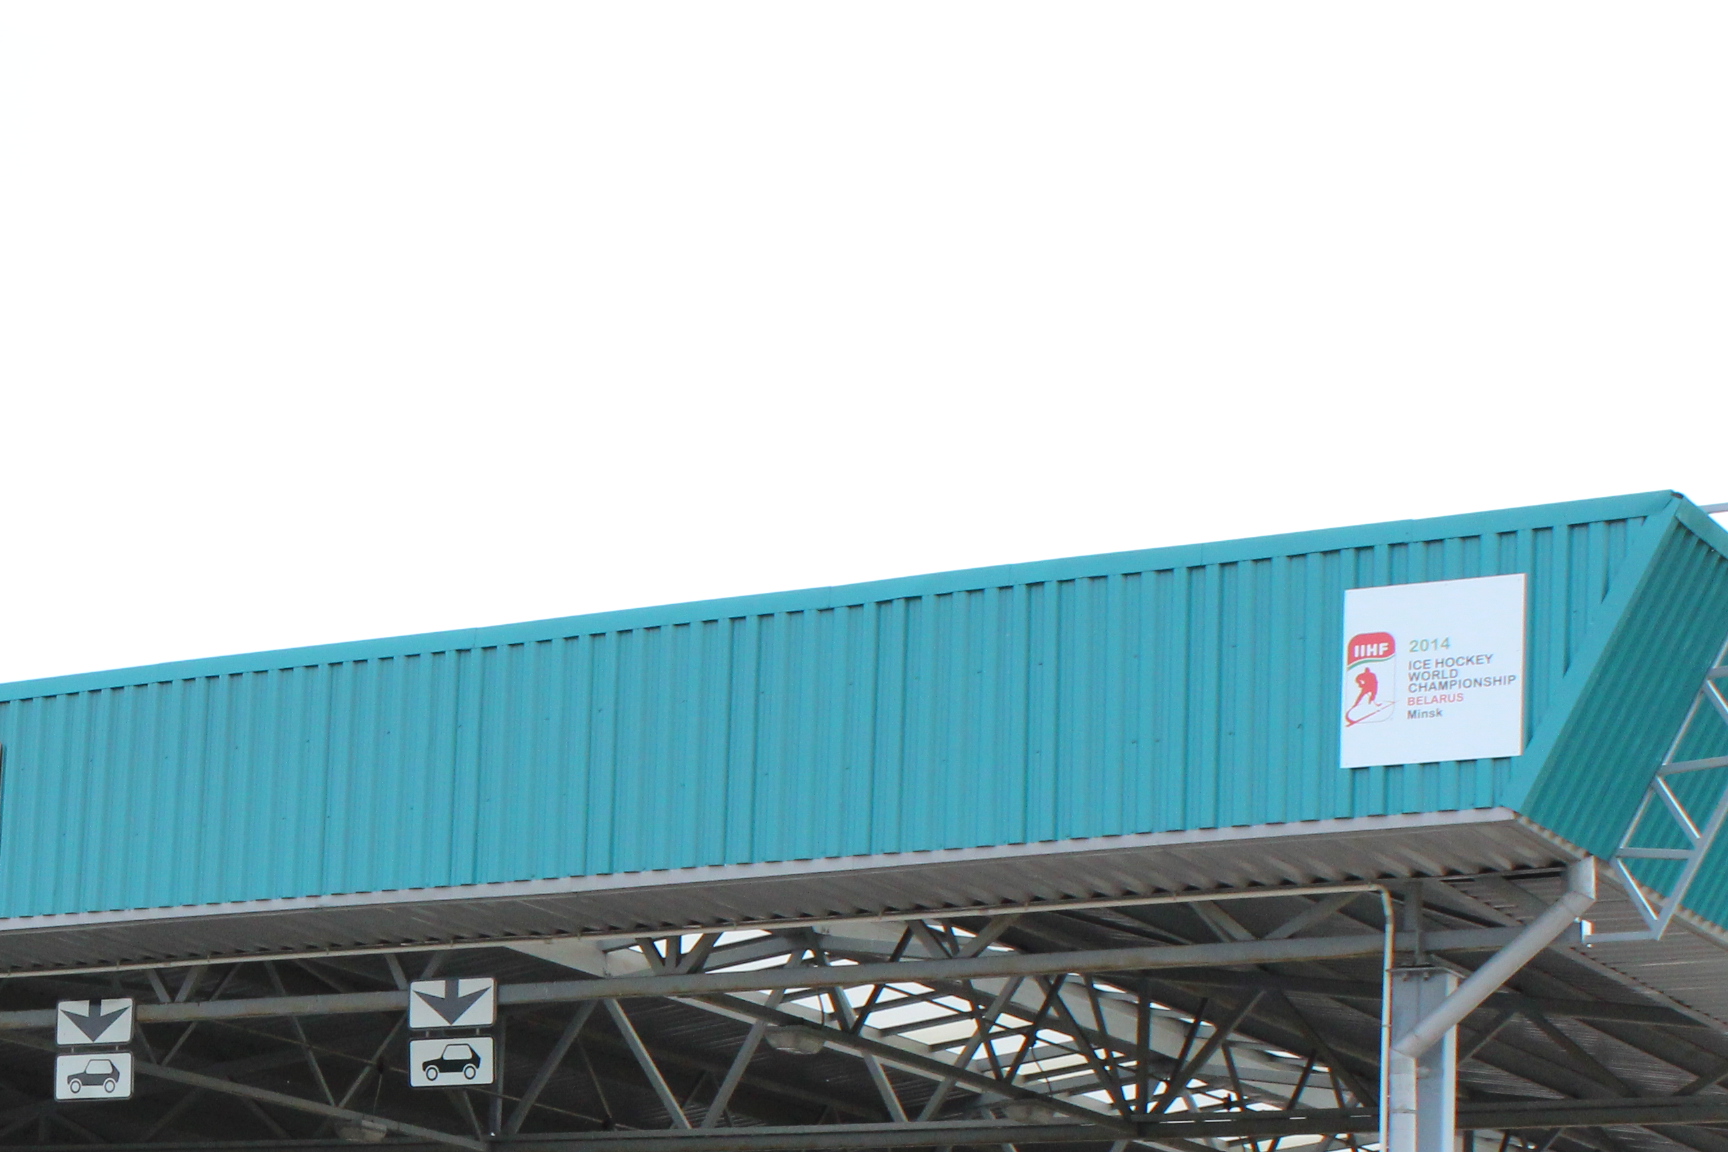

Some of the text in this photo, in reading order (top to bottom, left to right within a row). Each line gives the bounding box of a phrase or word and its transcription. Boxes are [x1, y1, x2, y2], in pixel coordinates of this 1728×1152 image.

[1354, 642, 1389, 658] IIHF
[1409, 637, 1451, 653] 2014
[1408, 653, 1494, 671] ICE HOCKEY
[1407, 668, 1459, 682] WORLD
[1408, 674, 1517, 694] CHAMPIONSHIP
[1407, 692, 1464, 706] BELARUS
[1407, 708, 1443, 720] Minsk
